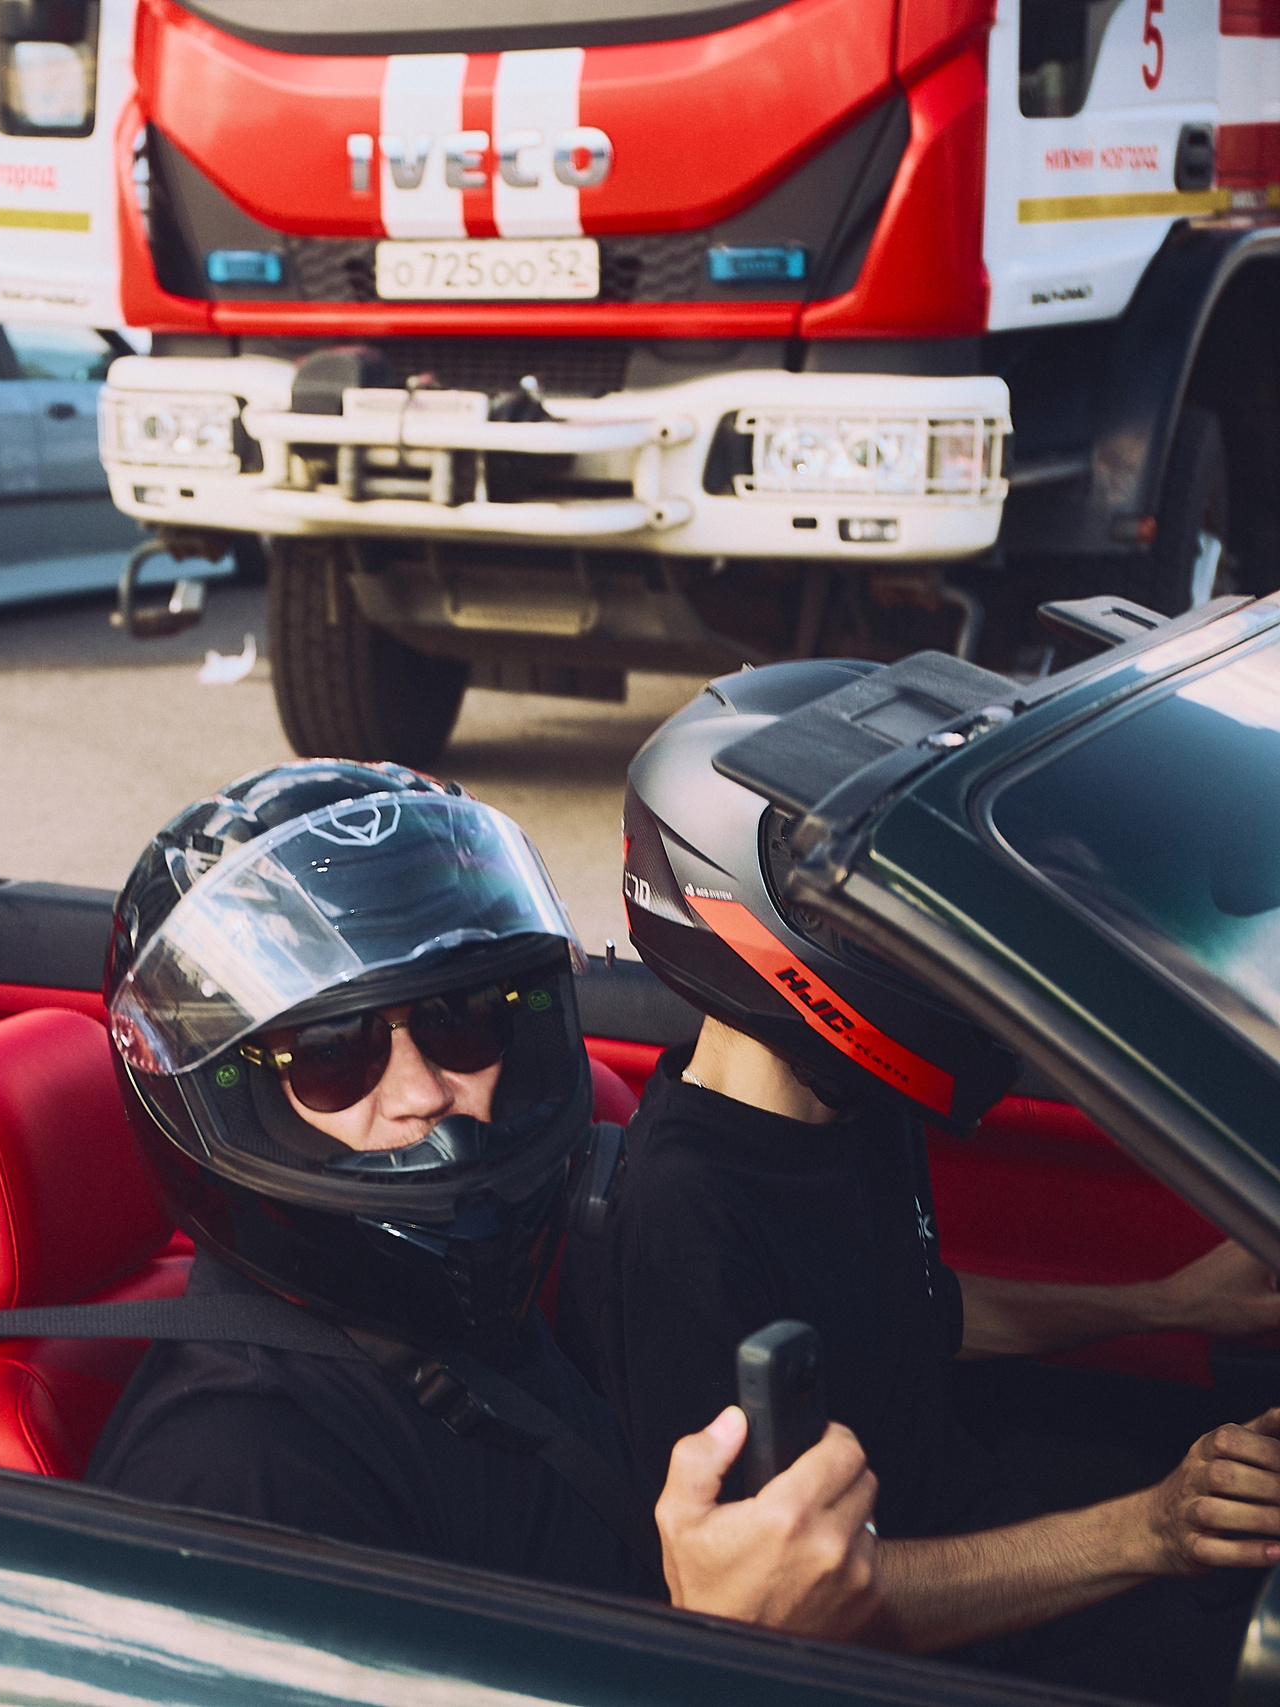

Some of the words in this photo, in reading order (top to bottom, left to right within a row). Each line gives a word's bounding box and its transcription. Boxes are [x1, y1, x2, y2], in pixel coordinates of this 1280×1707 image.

[1141, 0, 1164, 90] 5
[347, 127, 613, 192] IVECO
[777, 968, 854, 1033] HJC
